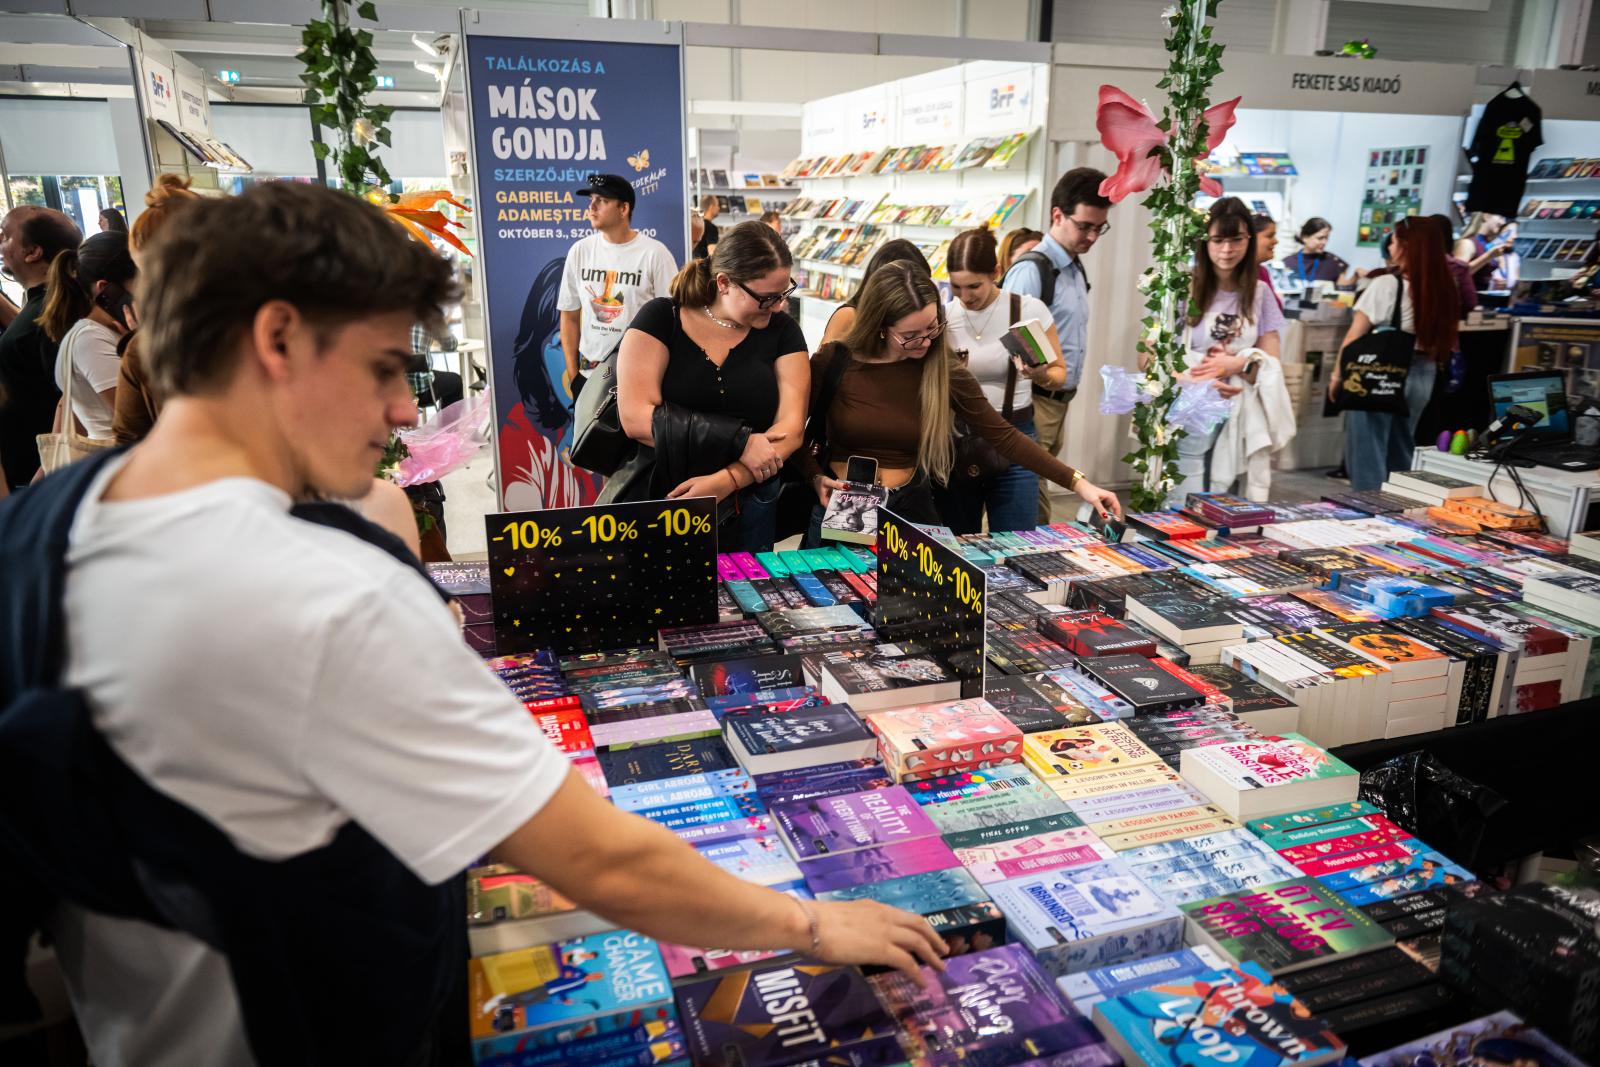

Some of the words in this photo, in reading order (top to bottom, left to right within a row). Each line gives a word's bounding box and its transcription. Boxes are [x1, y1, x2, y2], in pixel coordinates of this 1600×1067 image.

[486, 56, 591, 73] TALÁLKOZÁS
[595, 61, 605, 74] A
[1292, 72, 1336, 91] FEKETE
[1338, 74, 1360, 92] SAS
[1362, 74, 1401, 94] KIADÓ
[488, 78, 600, 120] MÁSOK
[492, 127, 606, 160] GONDJA
[496, 191, 574, 204] GABRIELA
[498, 209, 592, 224] ADAMEȘTEA
[498, 227, 552, 238] OKTÓBER
[556, 228, 569, 240] 3.,
[492, 520, 562, 550] -10%
[572, 514, 638, 544] -10%
[648, 508, 711, 536] -10%
[879, 521, 908, 561] -10%
[912, 542, 944, 586] -10%
[947, 567, 982, 614] -10%
[1105, 734, 1142, 759] FALLING
[1112, 728, 1150, 758] LESSONS
[1220, 746, 1282, 784] CHRISTMAS
[637, 782, 662, 794] GIRL
[664, 776, 706, 789] ABROAD
[988, 779, 1012, 792] UNTIL
[1012, 776, 1030, 786] YOU
[1076, 772, 1106, 784] LESSONS
[642, 794, 666, 806] GIRL
[670, 787, 714, 801] ABROAD
[1084, 782, 1117, 794] LESSONS
[1092, 793, 1126, 804] LESSONS
[662, 808, 680, 816] GIRL
[681, 800, 724, 814] REPUTATION
[860, 793, 912, 835] REALITY
[896, 804, 912, 817] THE
[1104, 804, 1138, 816] LESSONS
[1139, 802, 1148, 810] IN
[686, 812, 730, 825] REPUTATION
[830, 800, 872, 844] EVERYTHING
[1118, 816, 1154, 828] LESSONS
[980, 828, 1002, 839] FINAL
[1134, 828, 1173, 842] LESSONS
[1174, 828, 1184, 836] IN
[1323, 854, 1364, 868] Snowed
[1365, 850, 1378, 860] In
[1028, 885, 1074, 924] ARRANGED
[603, 936, 637, 1002] CHANGER
[623, 932, 664, 999] GAME
[969, 957, 1030, 1004] Play
[1215, 974, 1306, 1058] Thrown
[1158, 998, 1240, 1063] Loop
